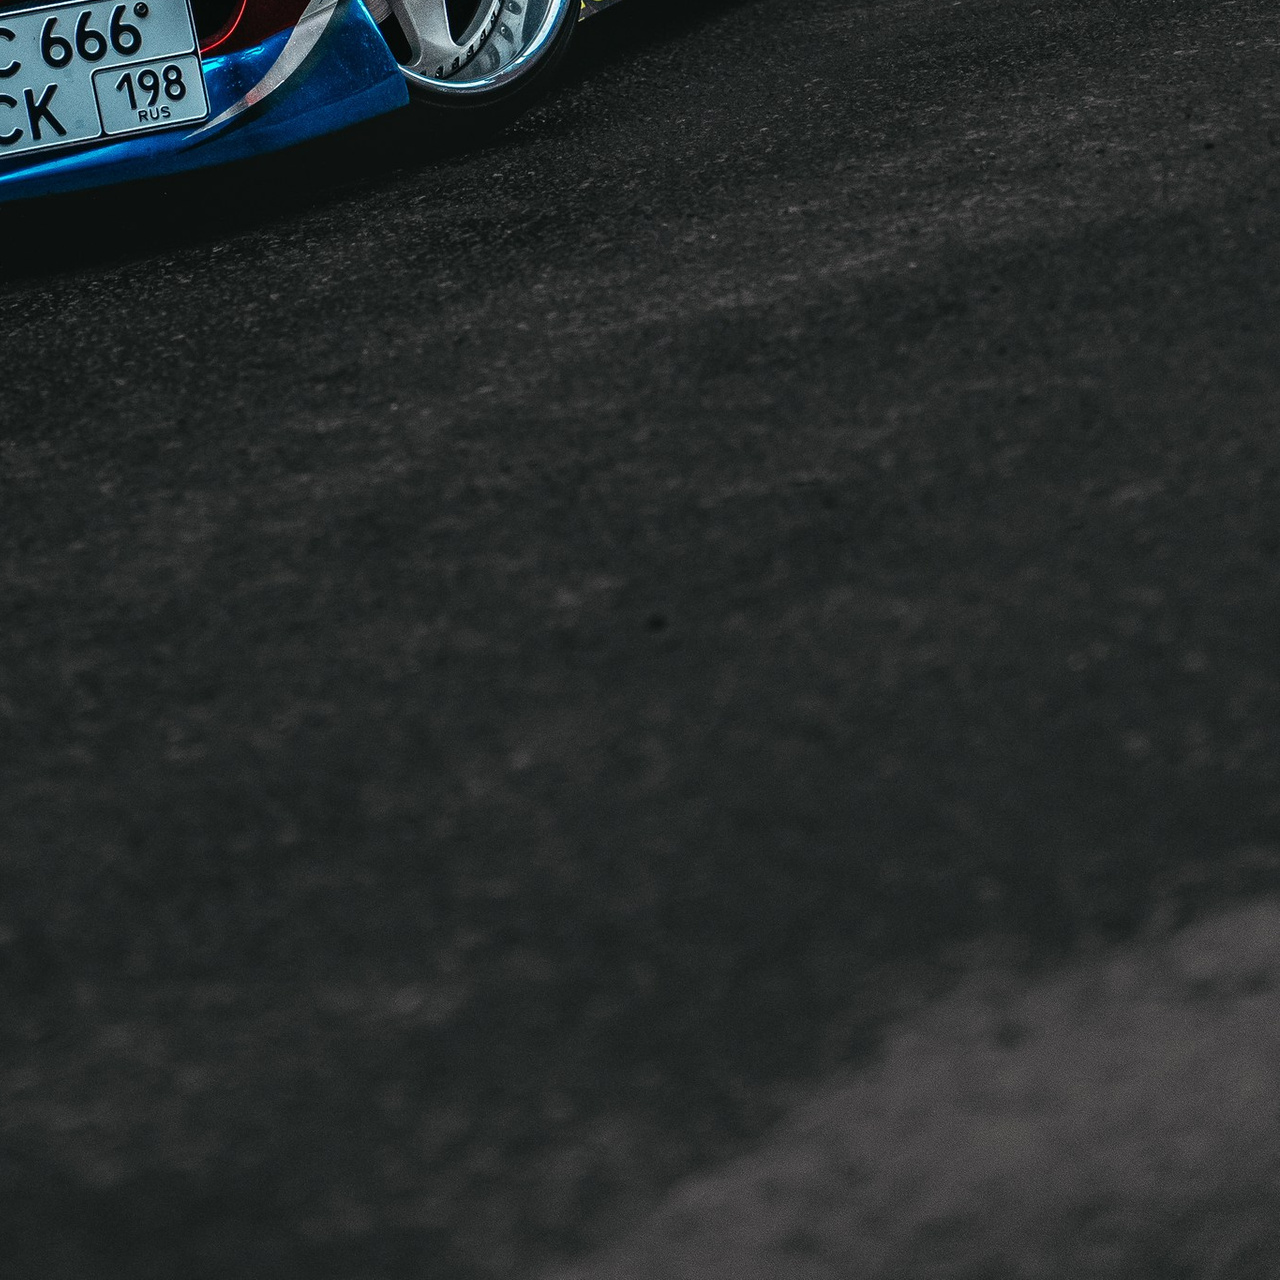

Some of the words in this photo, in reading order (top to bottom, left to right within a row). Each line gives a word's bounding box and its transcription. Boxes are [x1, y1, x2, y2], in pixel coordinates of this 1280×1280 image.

[39, 5, 143, 68] 666
[114, 64, 187, 111] 198
[137, 104, 172, 123] RUS
